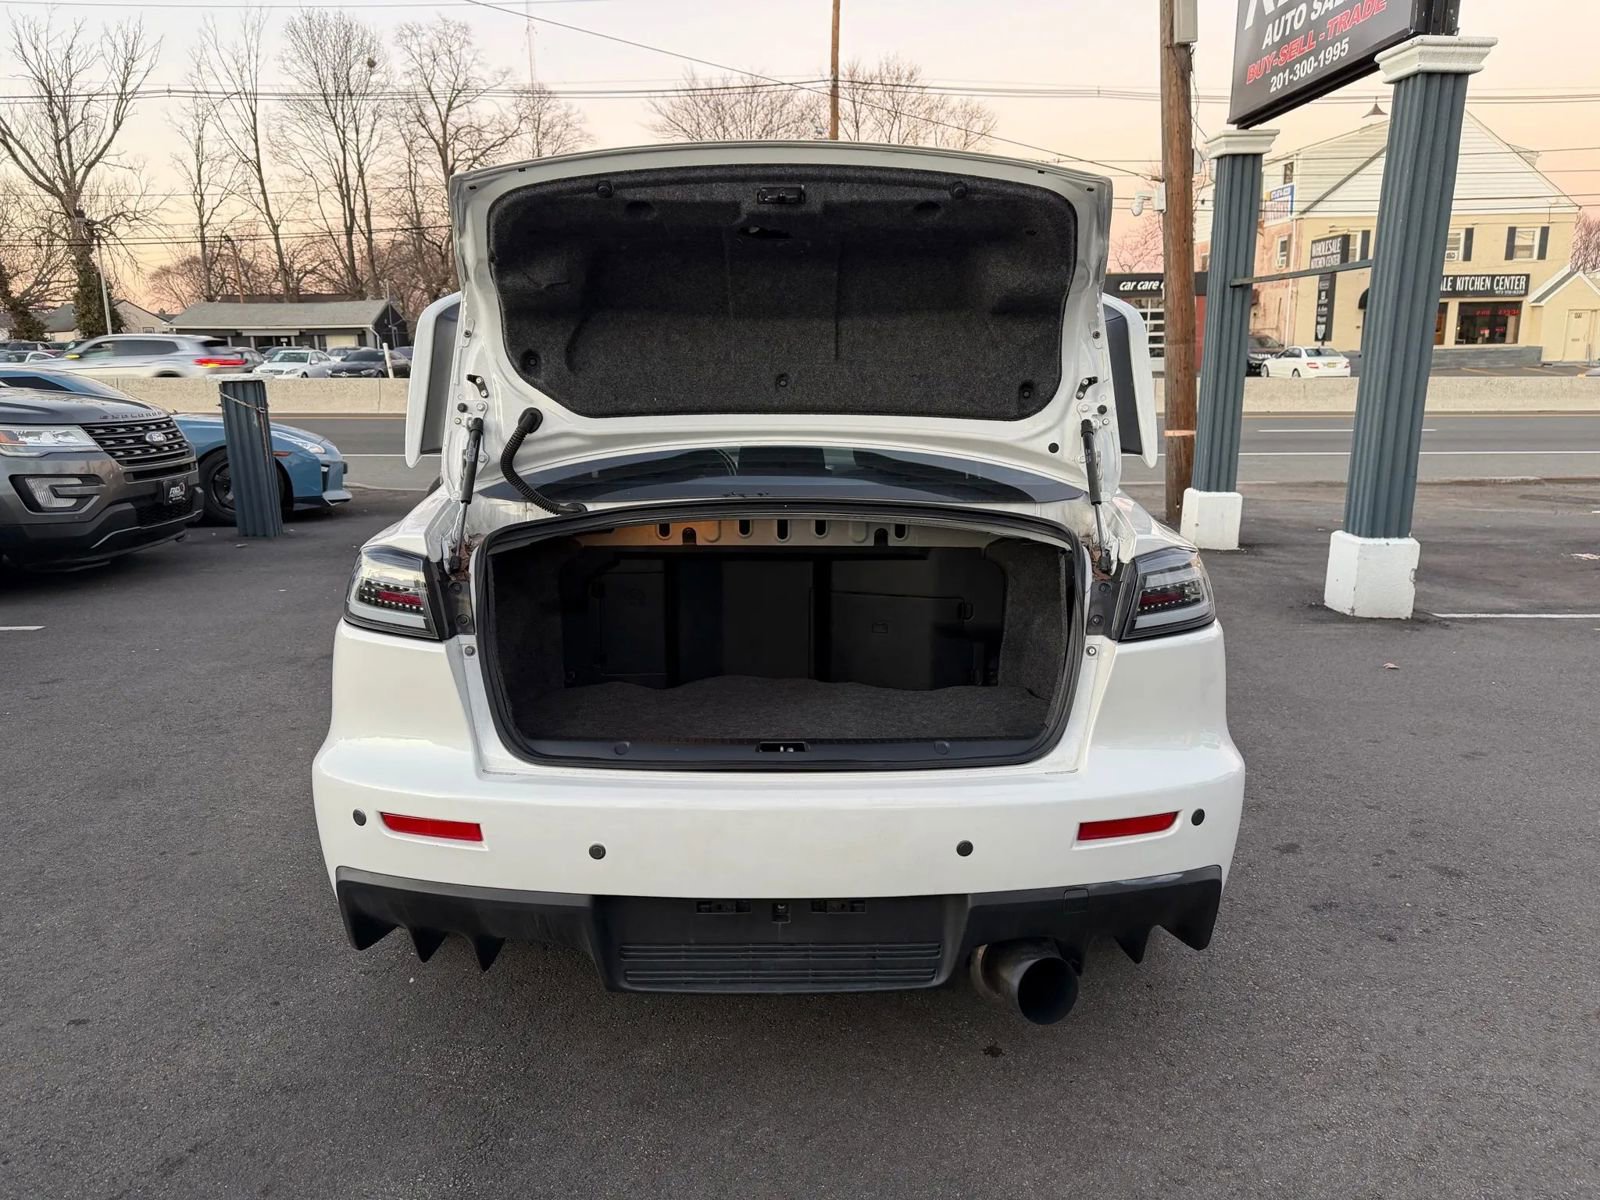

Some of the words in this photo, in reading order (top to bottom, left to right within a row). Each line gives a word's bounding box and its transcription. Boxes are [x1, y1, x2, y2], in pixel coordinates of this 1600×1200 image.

[1262, 3, 1307, 49] AUTO
[1269, 37, 1350, 93] 201-300-1995
[1311, 237, 1342, 257] WHOLESALE
[1119, 281, 1137, 291] car
[1137, 280, 1160, 290] care
[1455, 276, 1492, 291] KITCHEN
[1493, 275, 1527, 290] CENTER
